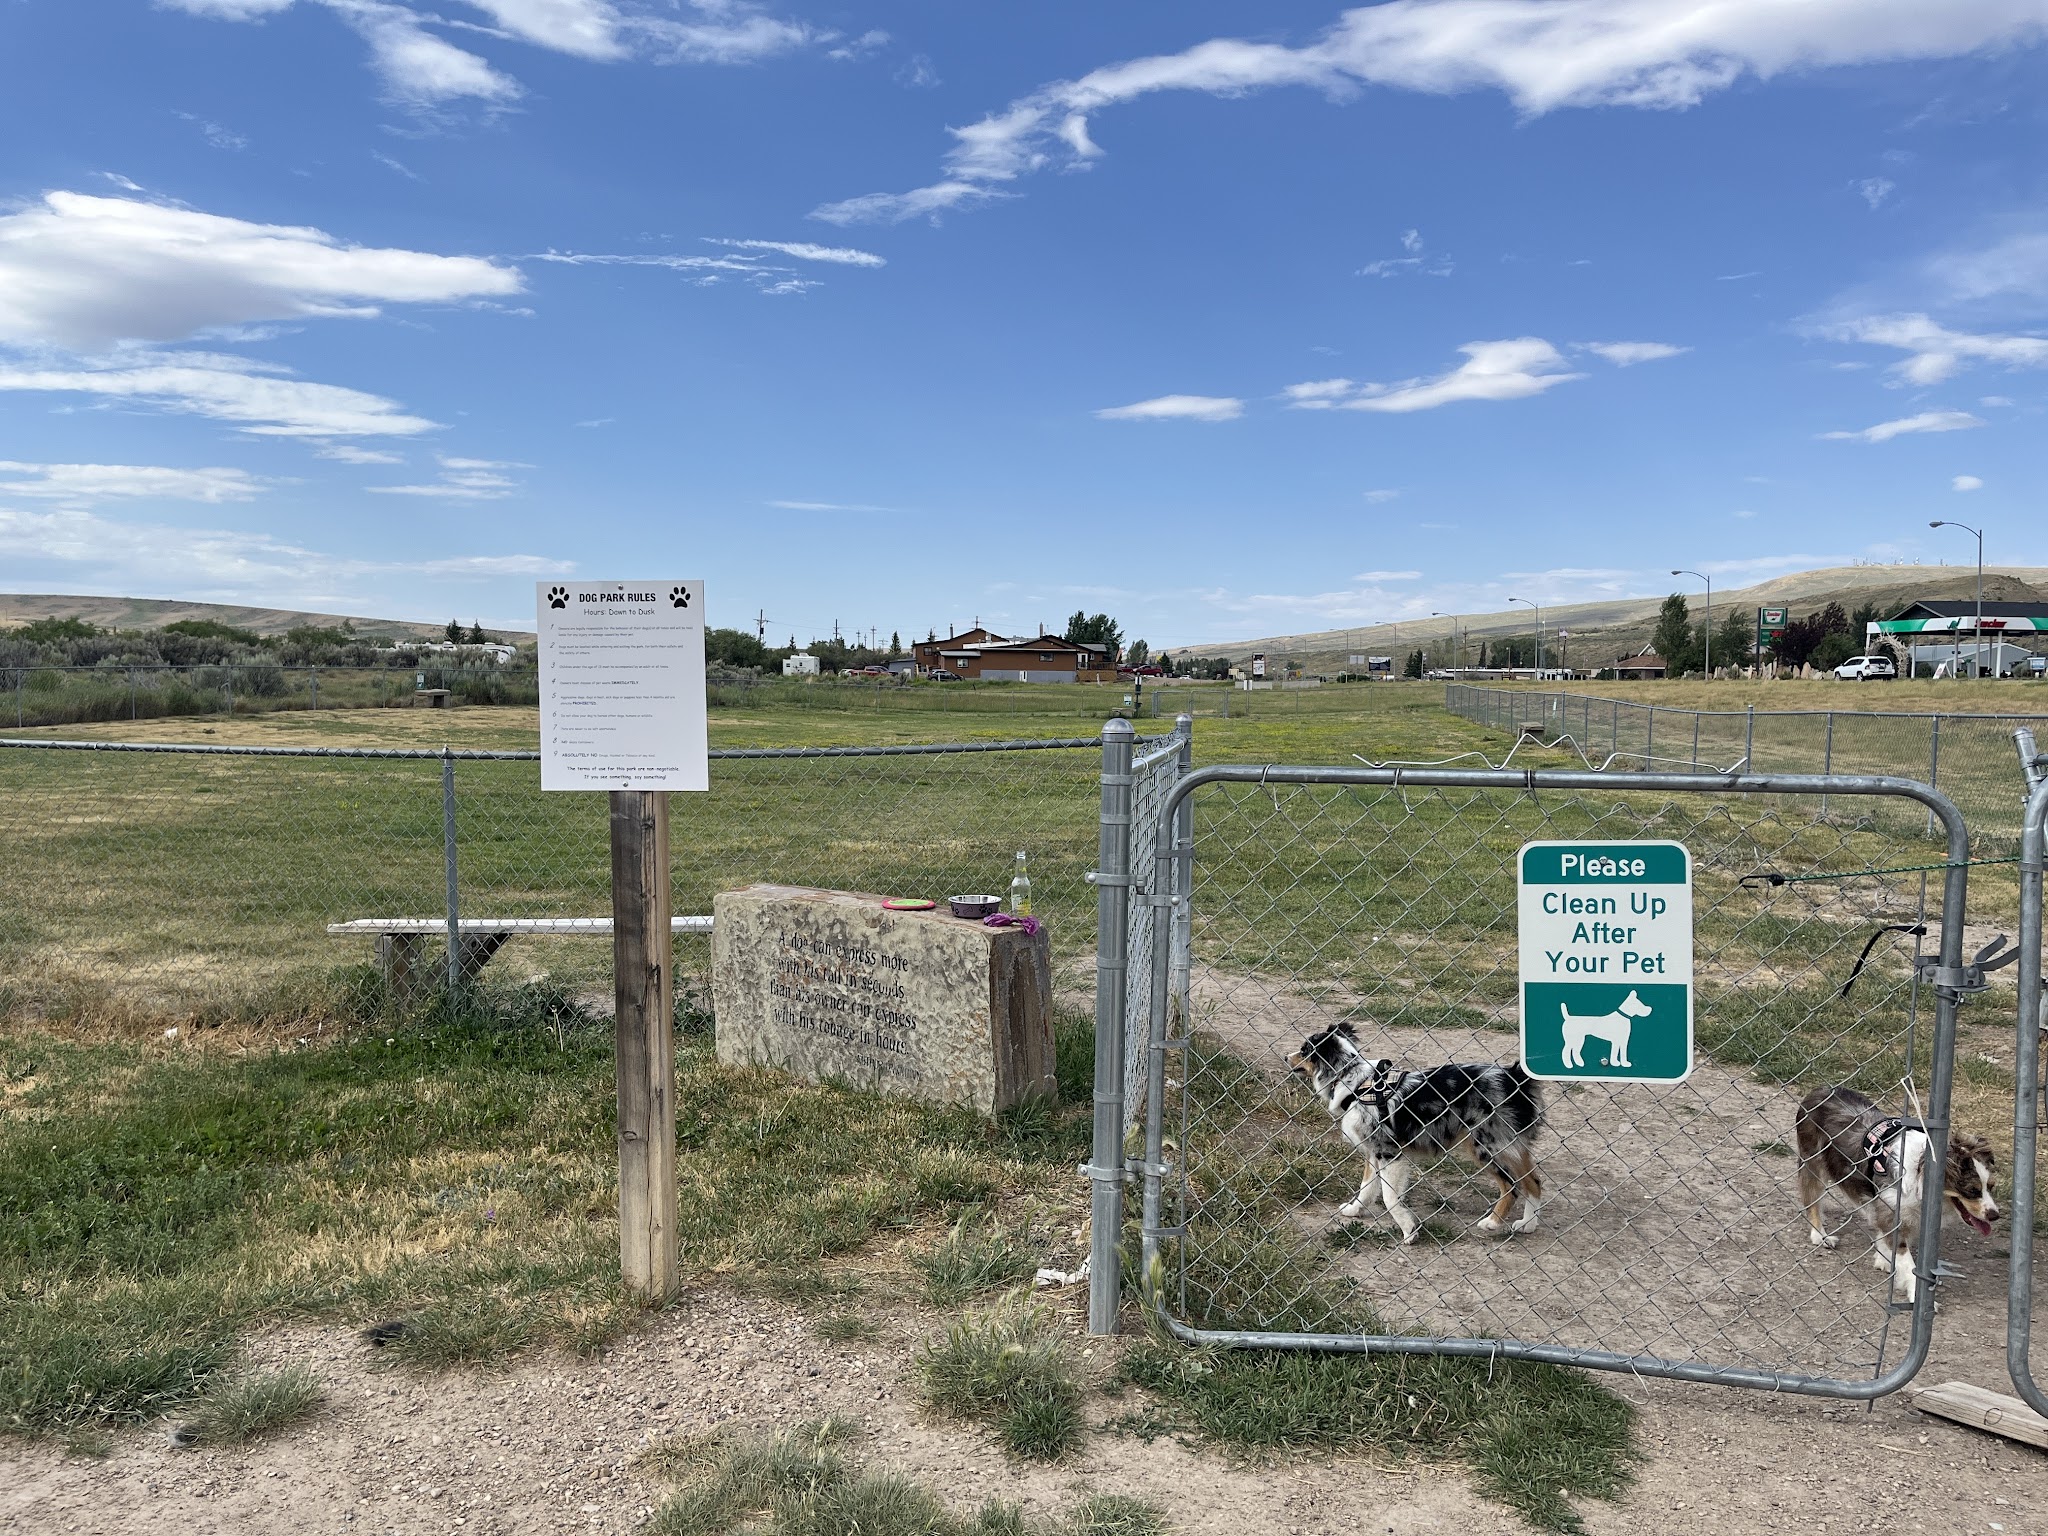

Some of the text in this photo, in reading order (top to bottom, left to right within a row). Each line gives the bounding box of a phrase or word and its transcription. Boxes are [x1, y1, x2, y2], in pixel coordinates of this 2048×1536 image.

[579, 592, 656, 602] DOG PARK RULES
[638, 608, 656, 616] Dusk
[1561, 854, 1646, 876] Please
[1542, 892, 1666, 920] Clean Up
[1572, 922, 1636, 944] After
[778, 932, 786, 947] A
[813, 940, 832, 956] can
[836, 944, 876, 966] express
[881, 954, 908, 972] more
[1545, 950, 1666, 974] Your Pet
[814, 992, 847, 1012] owner
[851, 1000, 870, 1018] can
[875, 1007, 917, 1030] express
[774, 1006, 795, 1026] with
[800, 1010, 815, 1031] his
[860, 1026, 870, 1044] in
[876, 1029, 910, 1056] hours.
